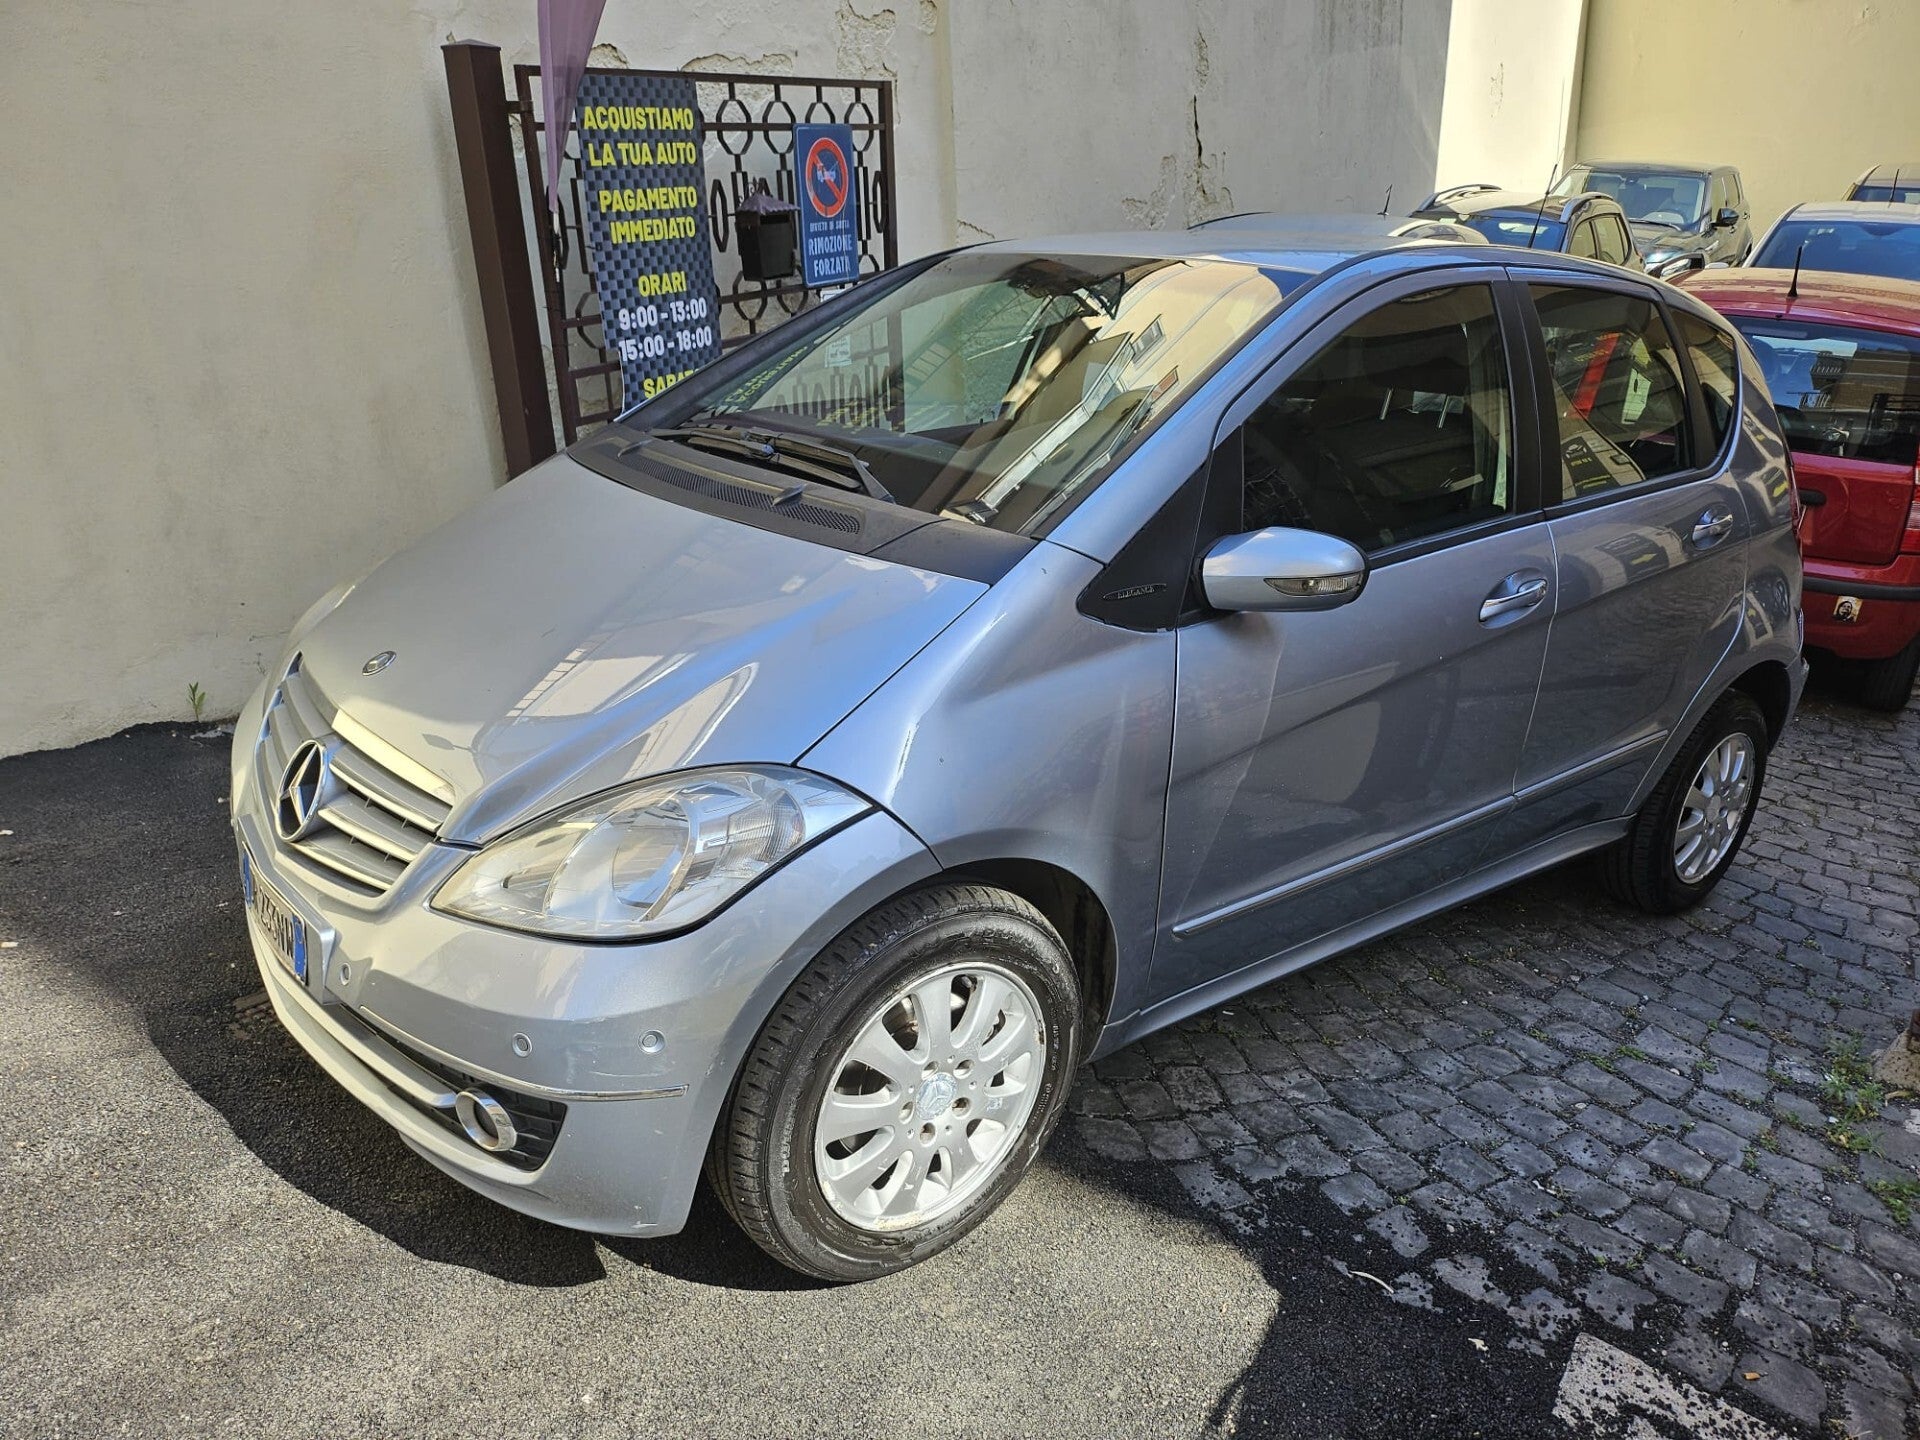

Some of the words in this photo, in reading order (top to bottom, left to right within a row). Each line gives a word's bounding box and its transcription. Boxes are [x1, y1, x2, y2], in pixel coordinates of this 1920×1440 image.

[583, 106, 694, 132] ACQUISTIAMO
[588, 143, 616, 167] LA
[618, 143, 653, 165] TUA
[657, 142, 697, 164] AUTO
[599, 186, 698, 213] PAGAMENTO
[610, 216, 696, 244] IMMEDIATO
[808, 235, 852, 255] RIMOZIONE
[814, 256, 850, 277] FORZATA
[638, 271, 687, 297] ORARI
[618, 304, 658, 331] 9:00
[669, 297, 707, 323] 13:00
[618, 335, 665, 361] 15:00
[676, 325, 712, 352] 18:00
[643, 369, 698, 399] SAB
